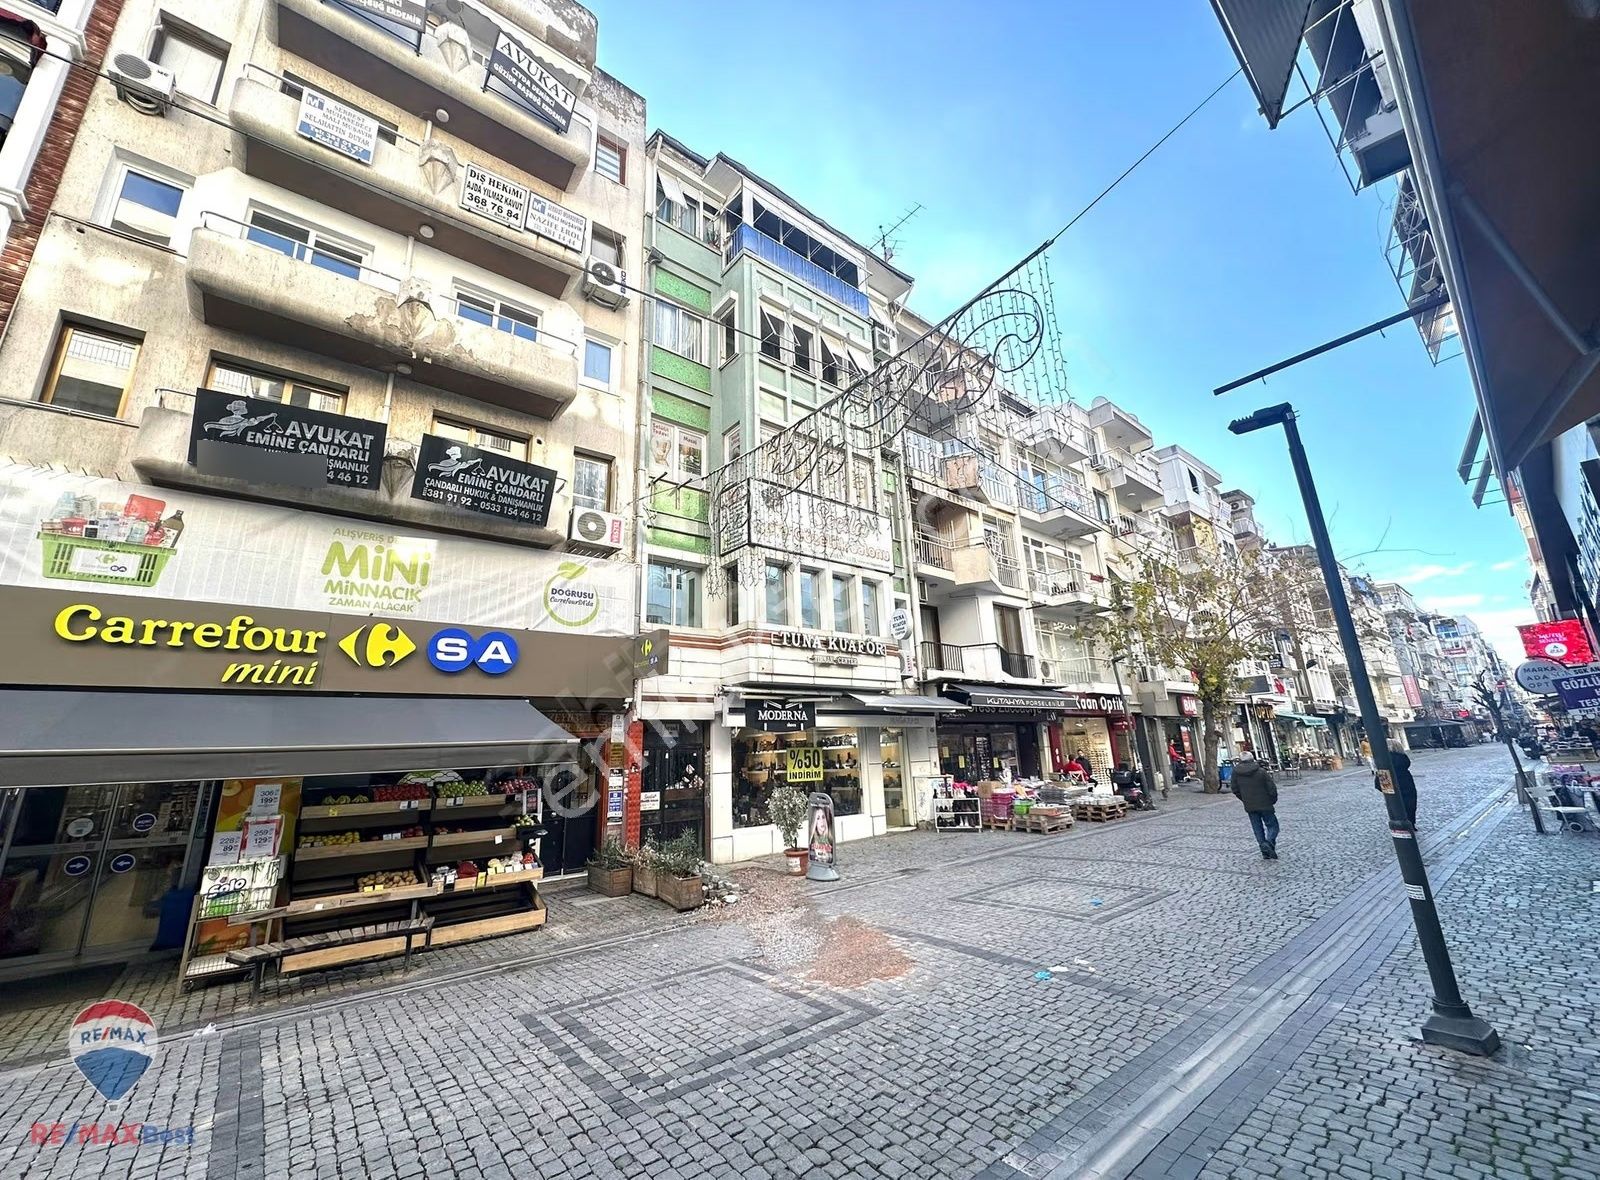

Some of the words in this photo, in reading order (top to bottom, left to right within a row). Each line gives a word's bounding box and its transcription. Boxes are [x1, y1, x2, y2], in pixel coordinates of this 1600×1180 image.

[500, 42, 572, 105] AVUKAT
[334, 105, 366, 123] SERBEST
[466, 180, 482, 194] AJDA
[482, 187, 504, 203] YILMAZ
[504, 197, 523, 211] KAVUT
[466, 192, 487, 207] 368
[491, 202, 504, 214] 76
[506, 210, 519, 220] 84
[560, 226, 581, 242] EROL
[285, 420, 374, 450] AVUKAT
[298, 440, 370, 462] ÇANDARLI
[338, 472, 352, 482] 46
[356, 474, 368, 485] 12
[485, 466, 550, 494] AVUKAT
[424, 477, 463, 494] ÇANDARLI
[464, 486, 489, 501] HUKUK
[490, 493, 496, 502] &
[497, 494, 544, 512] DANIŞMANLIK
[494, 482, 545, 503] ÇANDARLI
[428, 488, 444, 500] 381
[446, 493, 457, 503] 91
[460, 496, 472, 507] 92
[480, 500, 501, 513] 0533
[503, 507, 518, 517] 154
[520, 510, 530, 520] 46
[532, 512, 542, 522] 12
[550, 586, 594, 600] DOĞRUSU
[328, 596, 370, 610] ZAMAN
[373, 599, 414, 612] ALACAK
[893, 614, 904, 622] TUNA
[54, 604, 327, 654] Carrefour
[780, 632, 822, 650] TUNA
[828, 636, 886, 656] KUAFÖR
[220, 659, 320, 685] mini
[1100, 696, 1125, 714] Optik
[758, 710, 808, 722] MODERNA
[790, 750, 820, 769] %50
[207, 878, 246, 899] Solo
